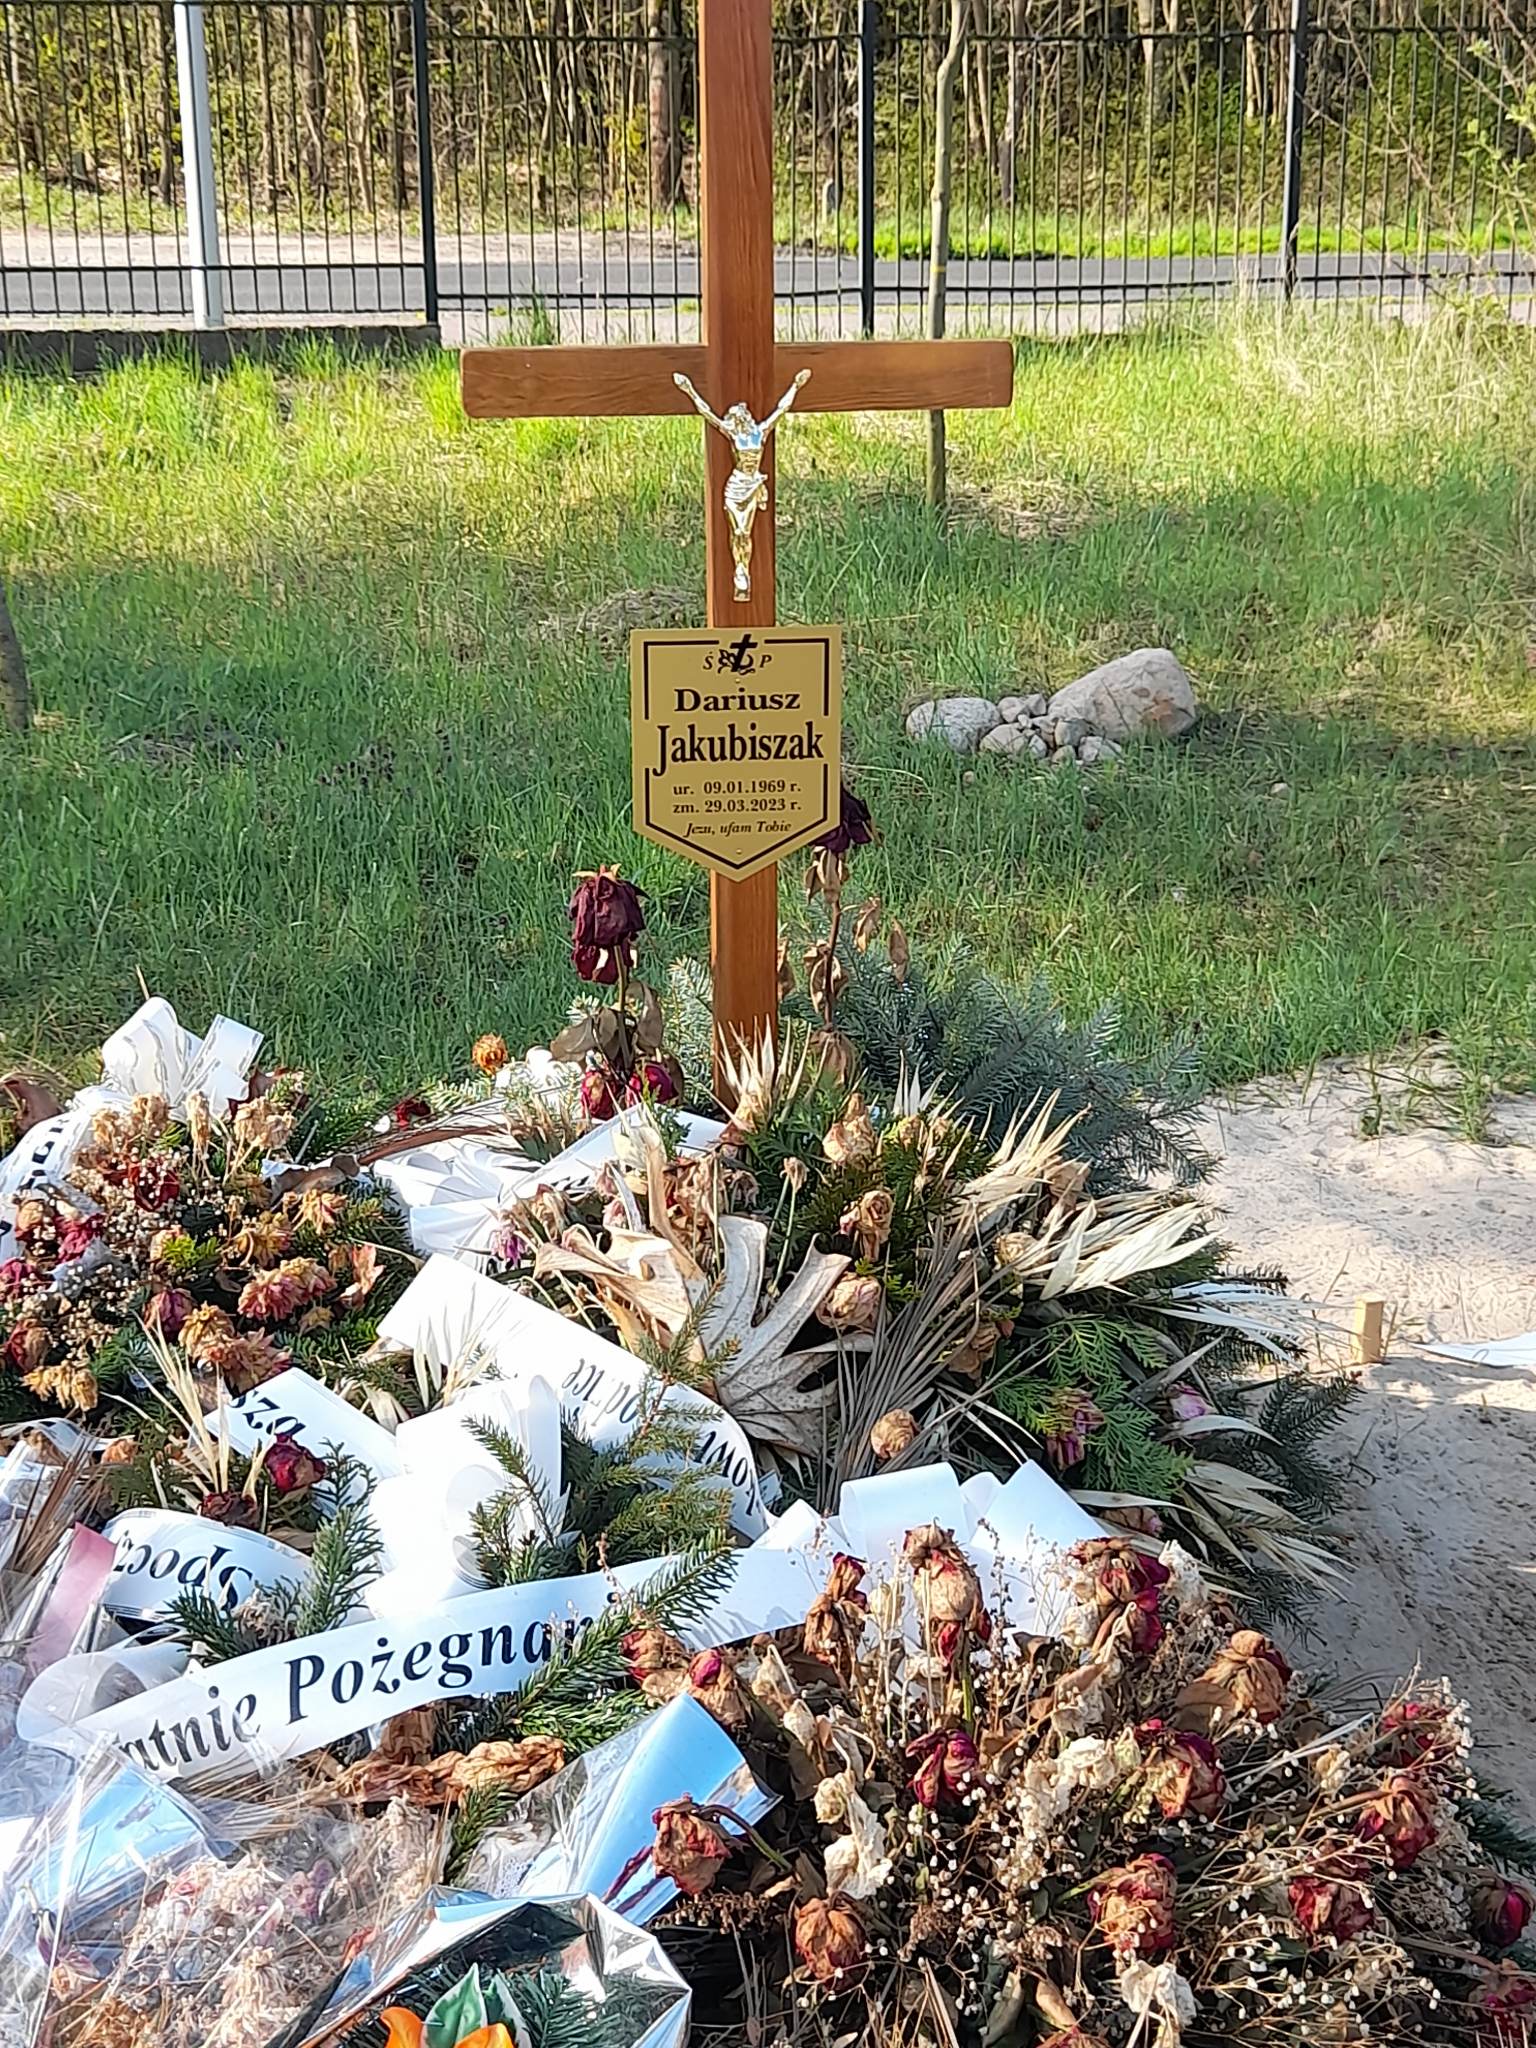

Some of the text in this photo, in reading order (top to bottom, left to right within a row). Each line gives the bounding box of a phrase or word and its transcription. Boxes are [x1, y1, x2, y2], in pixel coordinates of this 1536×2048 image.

[759, 654, 773, 669] P
[673, 687, 801, 712] Dariusz
[652, 720, 825, 778] Jakubiszak
[672, 780, 802, 796] ur. 09.01.1969 r.
[672, 798, 802, 814] zm. 29.03.2023 r.
[682, 820, 792, 838] Jezu, ufam Tobie
[112, 1529, 253, 1613] Spocz
